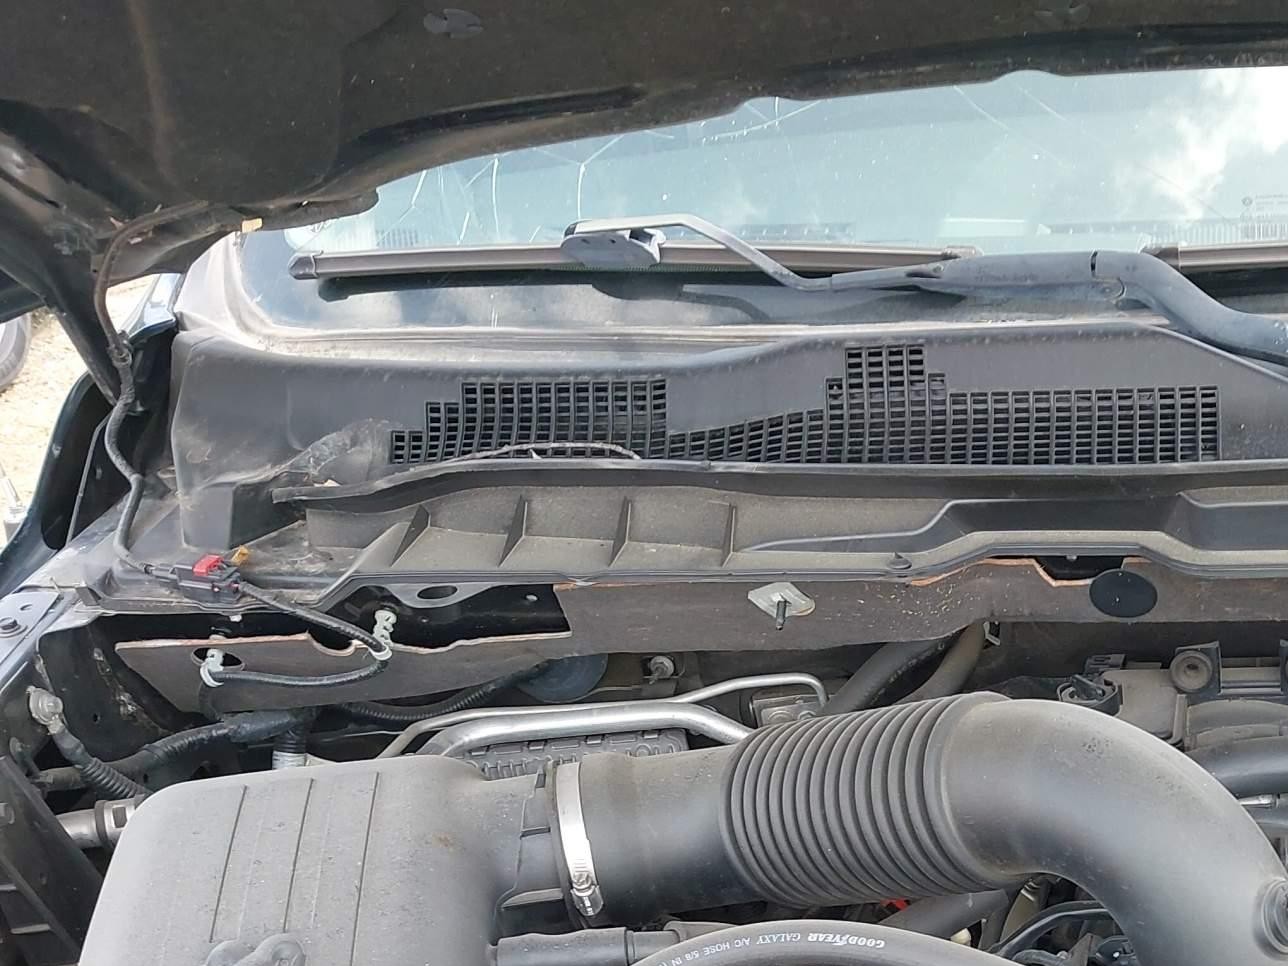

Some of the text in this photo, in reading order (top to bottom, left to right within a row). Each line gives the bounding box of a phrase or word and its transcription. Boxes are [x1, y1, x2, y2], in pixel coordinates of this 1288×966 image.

[734, 937, 751, 948] A/C
[756, 932, 801, 944] GALAXY
[808, 932, 886, 949] GOODYEAR
[703, 938, 730, 955] HOSE
